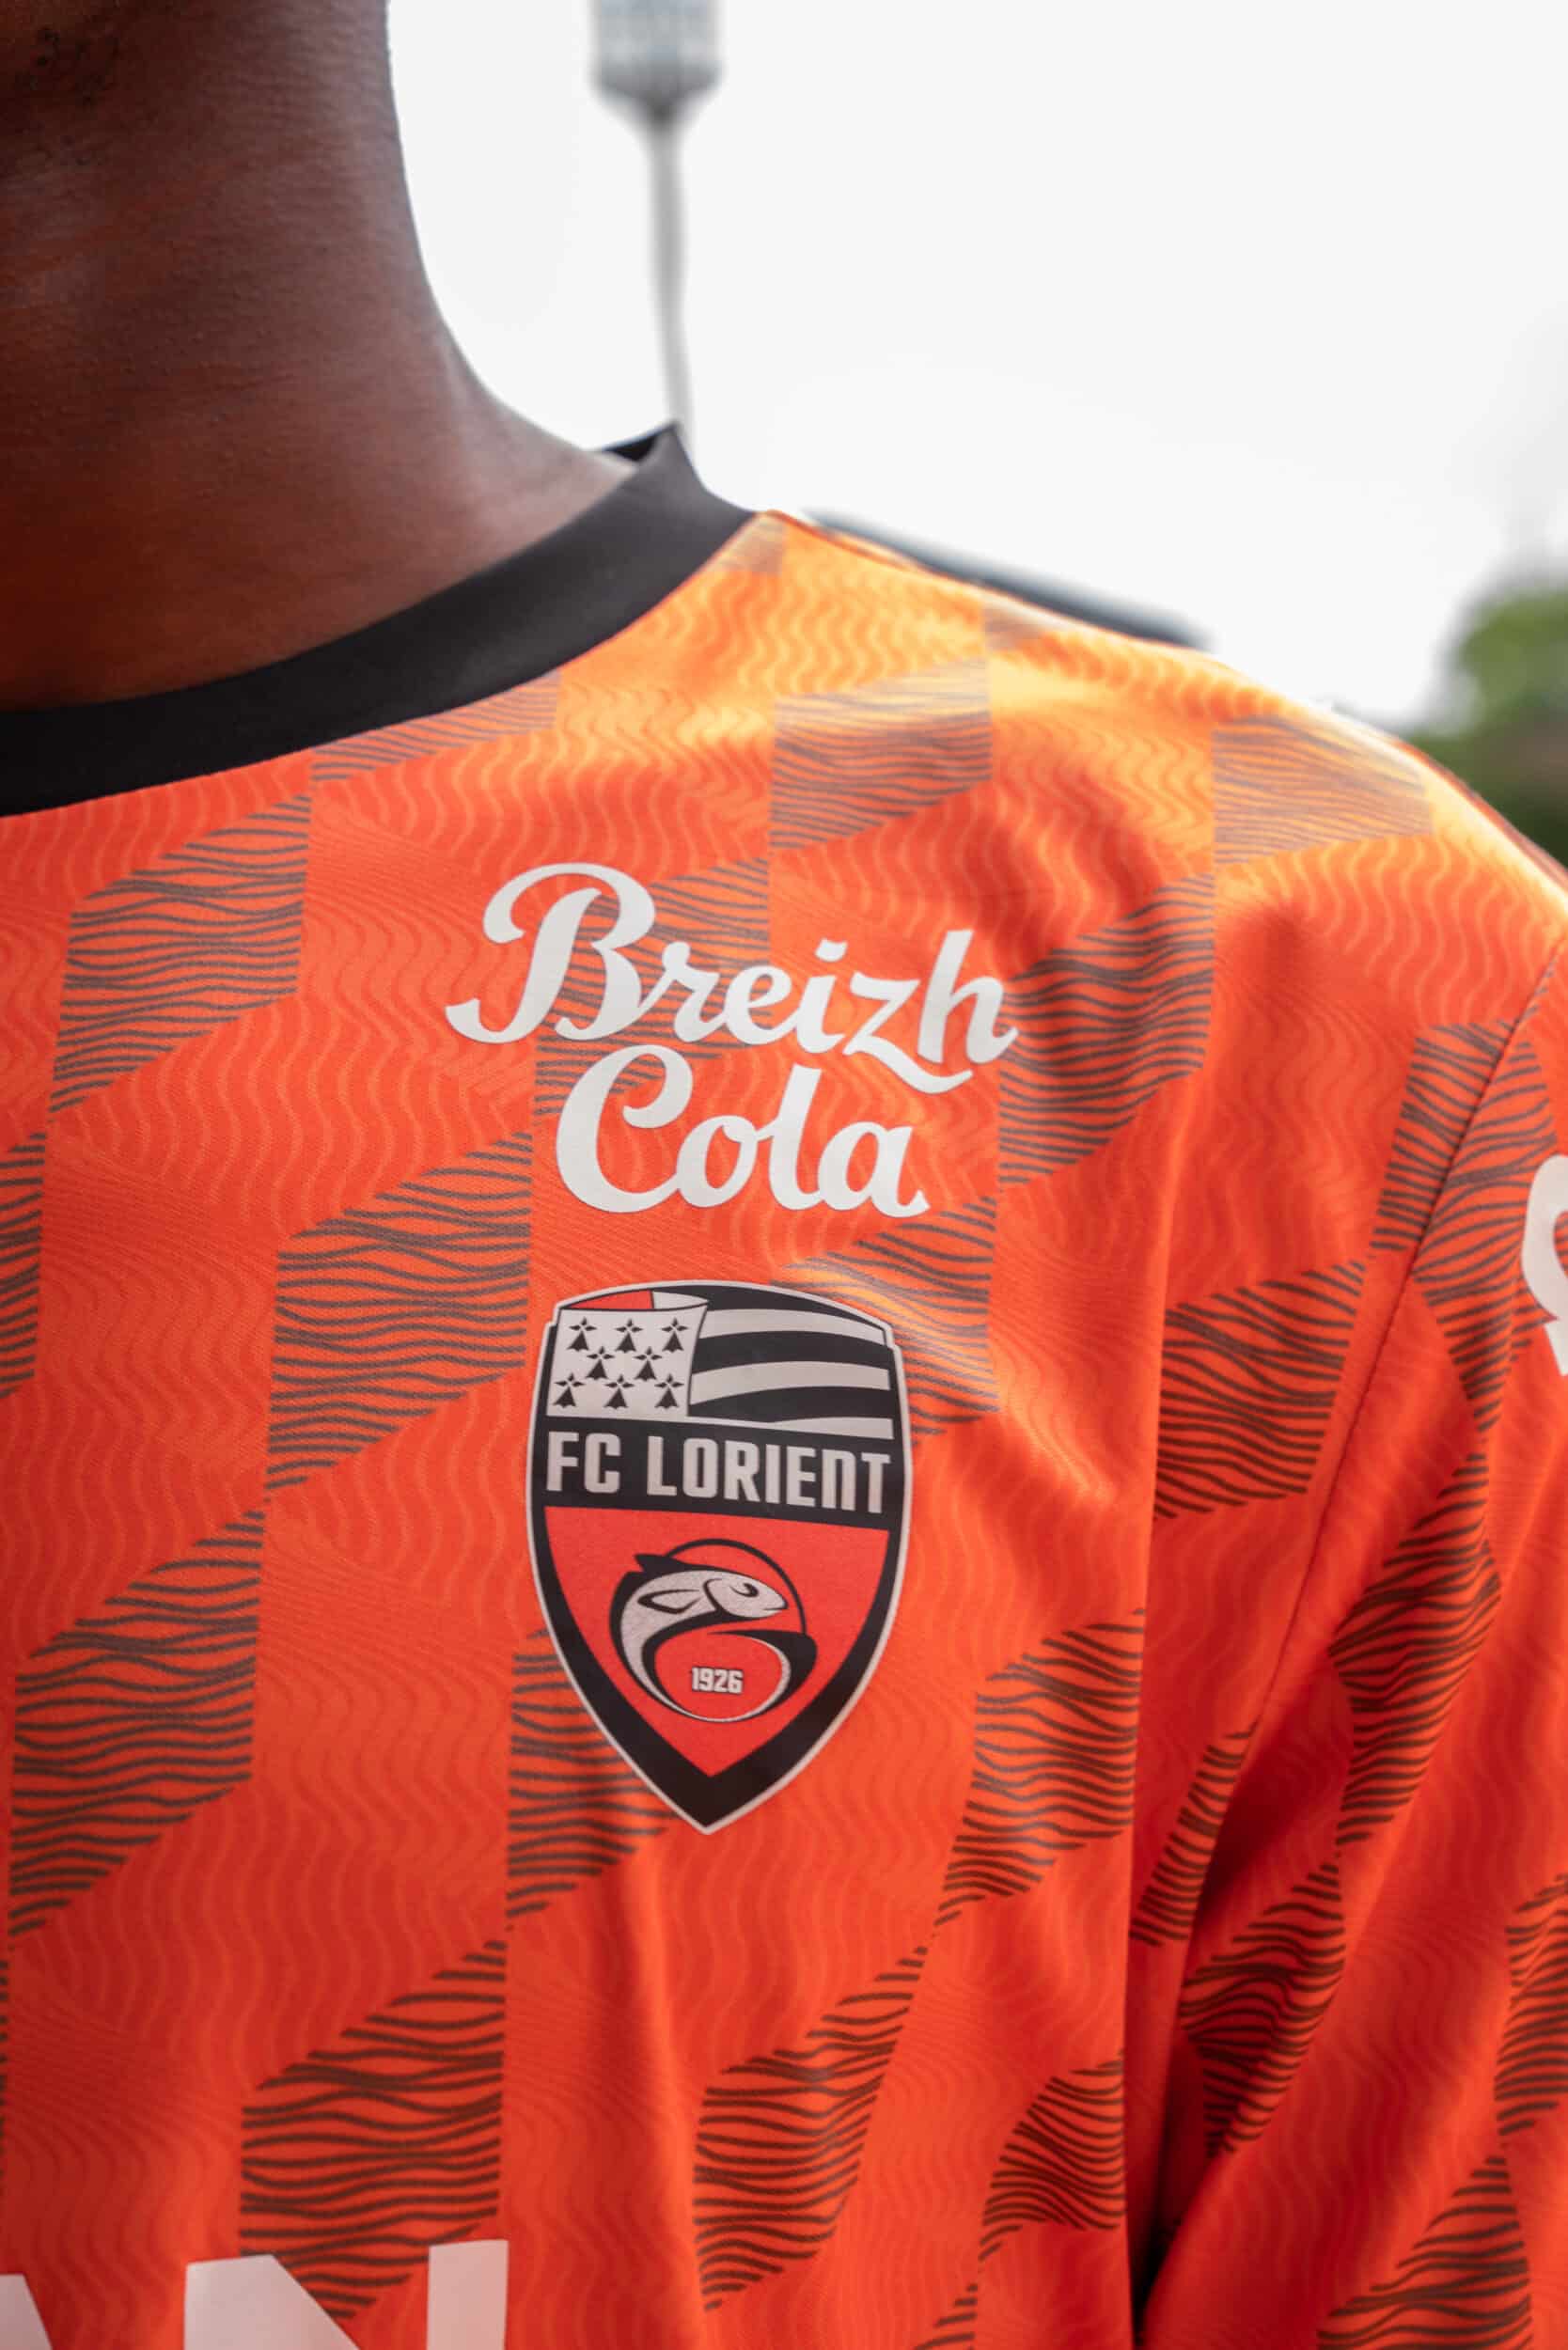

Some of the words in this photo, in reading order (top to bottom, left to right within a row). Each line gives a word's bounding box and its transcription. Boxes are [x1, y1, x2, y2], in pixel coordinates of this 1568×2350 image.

[445, 862, 1019, 1094] Breizh
[556, 1044, 931, 1218] Cola
[546, 1430, 621, 1495] FC
[646, 1434, 892, 1514] LORIENT
[691, 1666, 744, 1695] 1926
